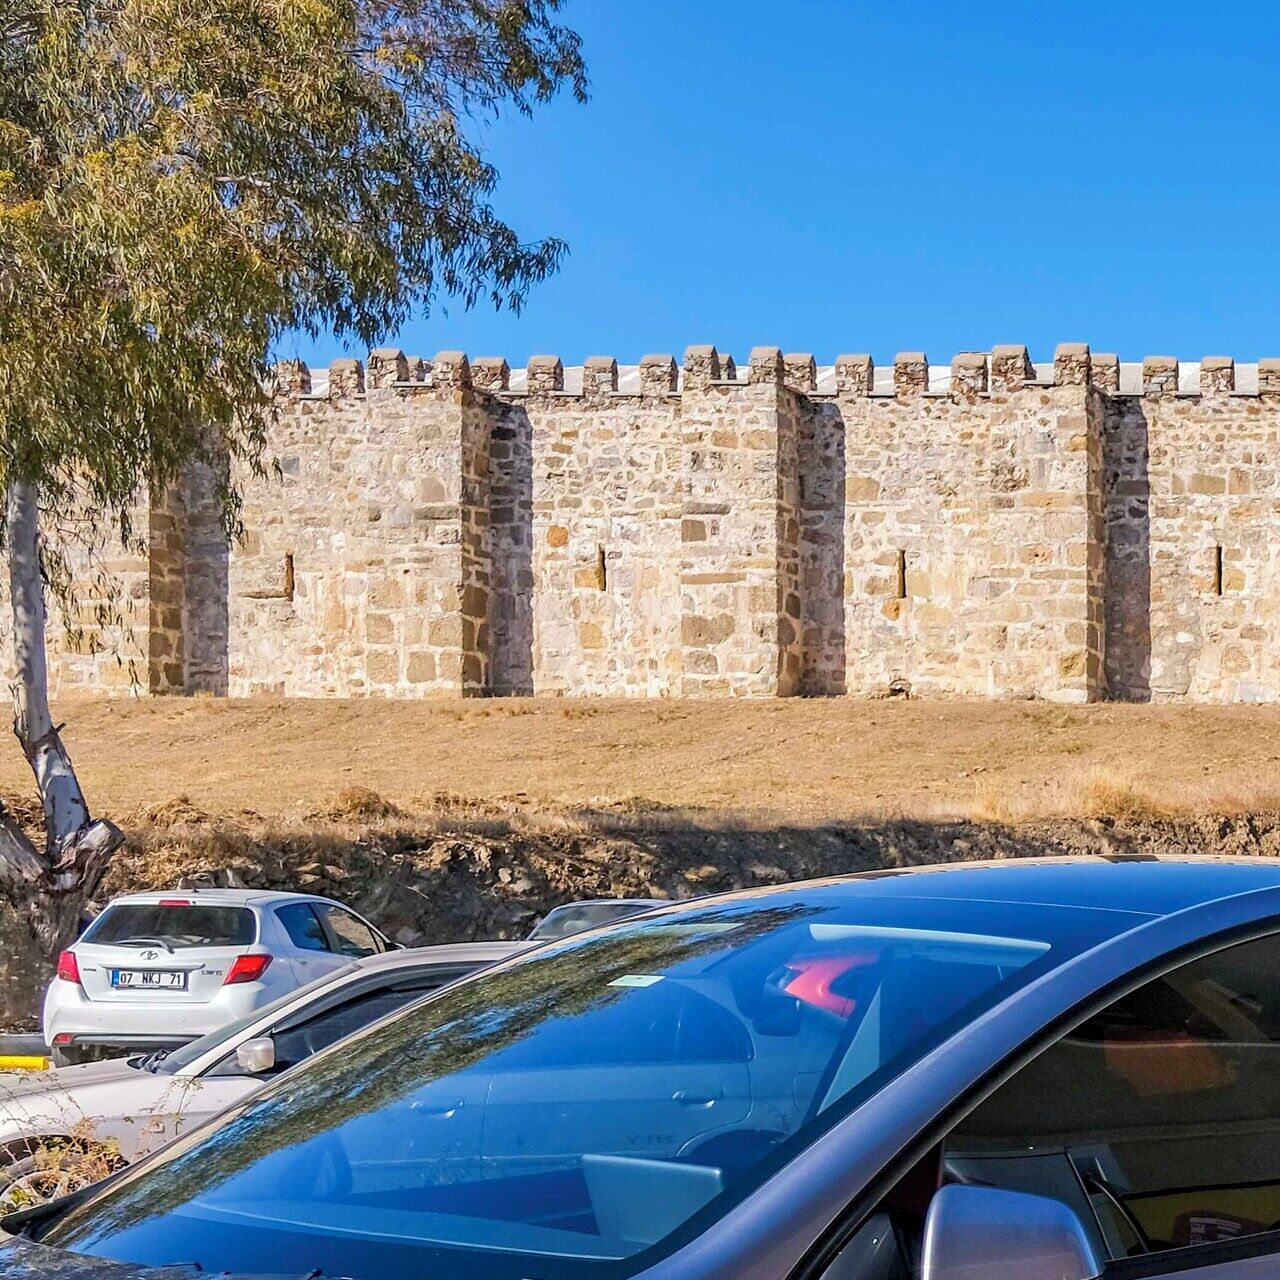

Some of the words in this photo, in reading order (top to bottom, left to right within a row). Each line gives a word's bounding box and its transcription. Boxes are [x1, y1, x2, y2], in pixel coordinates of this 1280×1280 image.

[120, 972, 133, 985] 07
[141, 972, 162, 985] NKJ
[169, 973, 182, 986] 71
